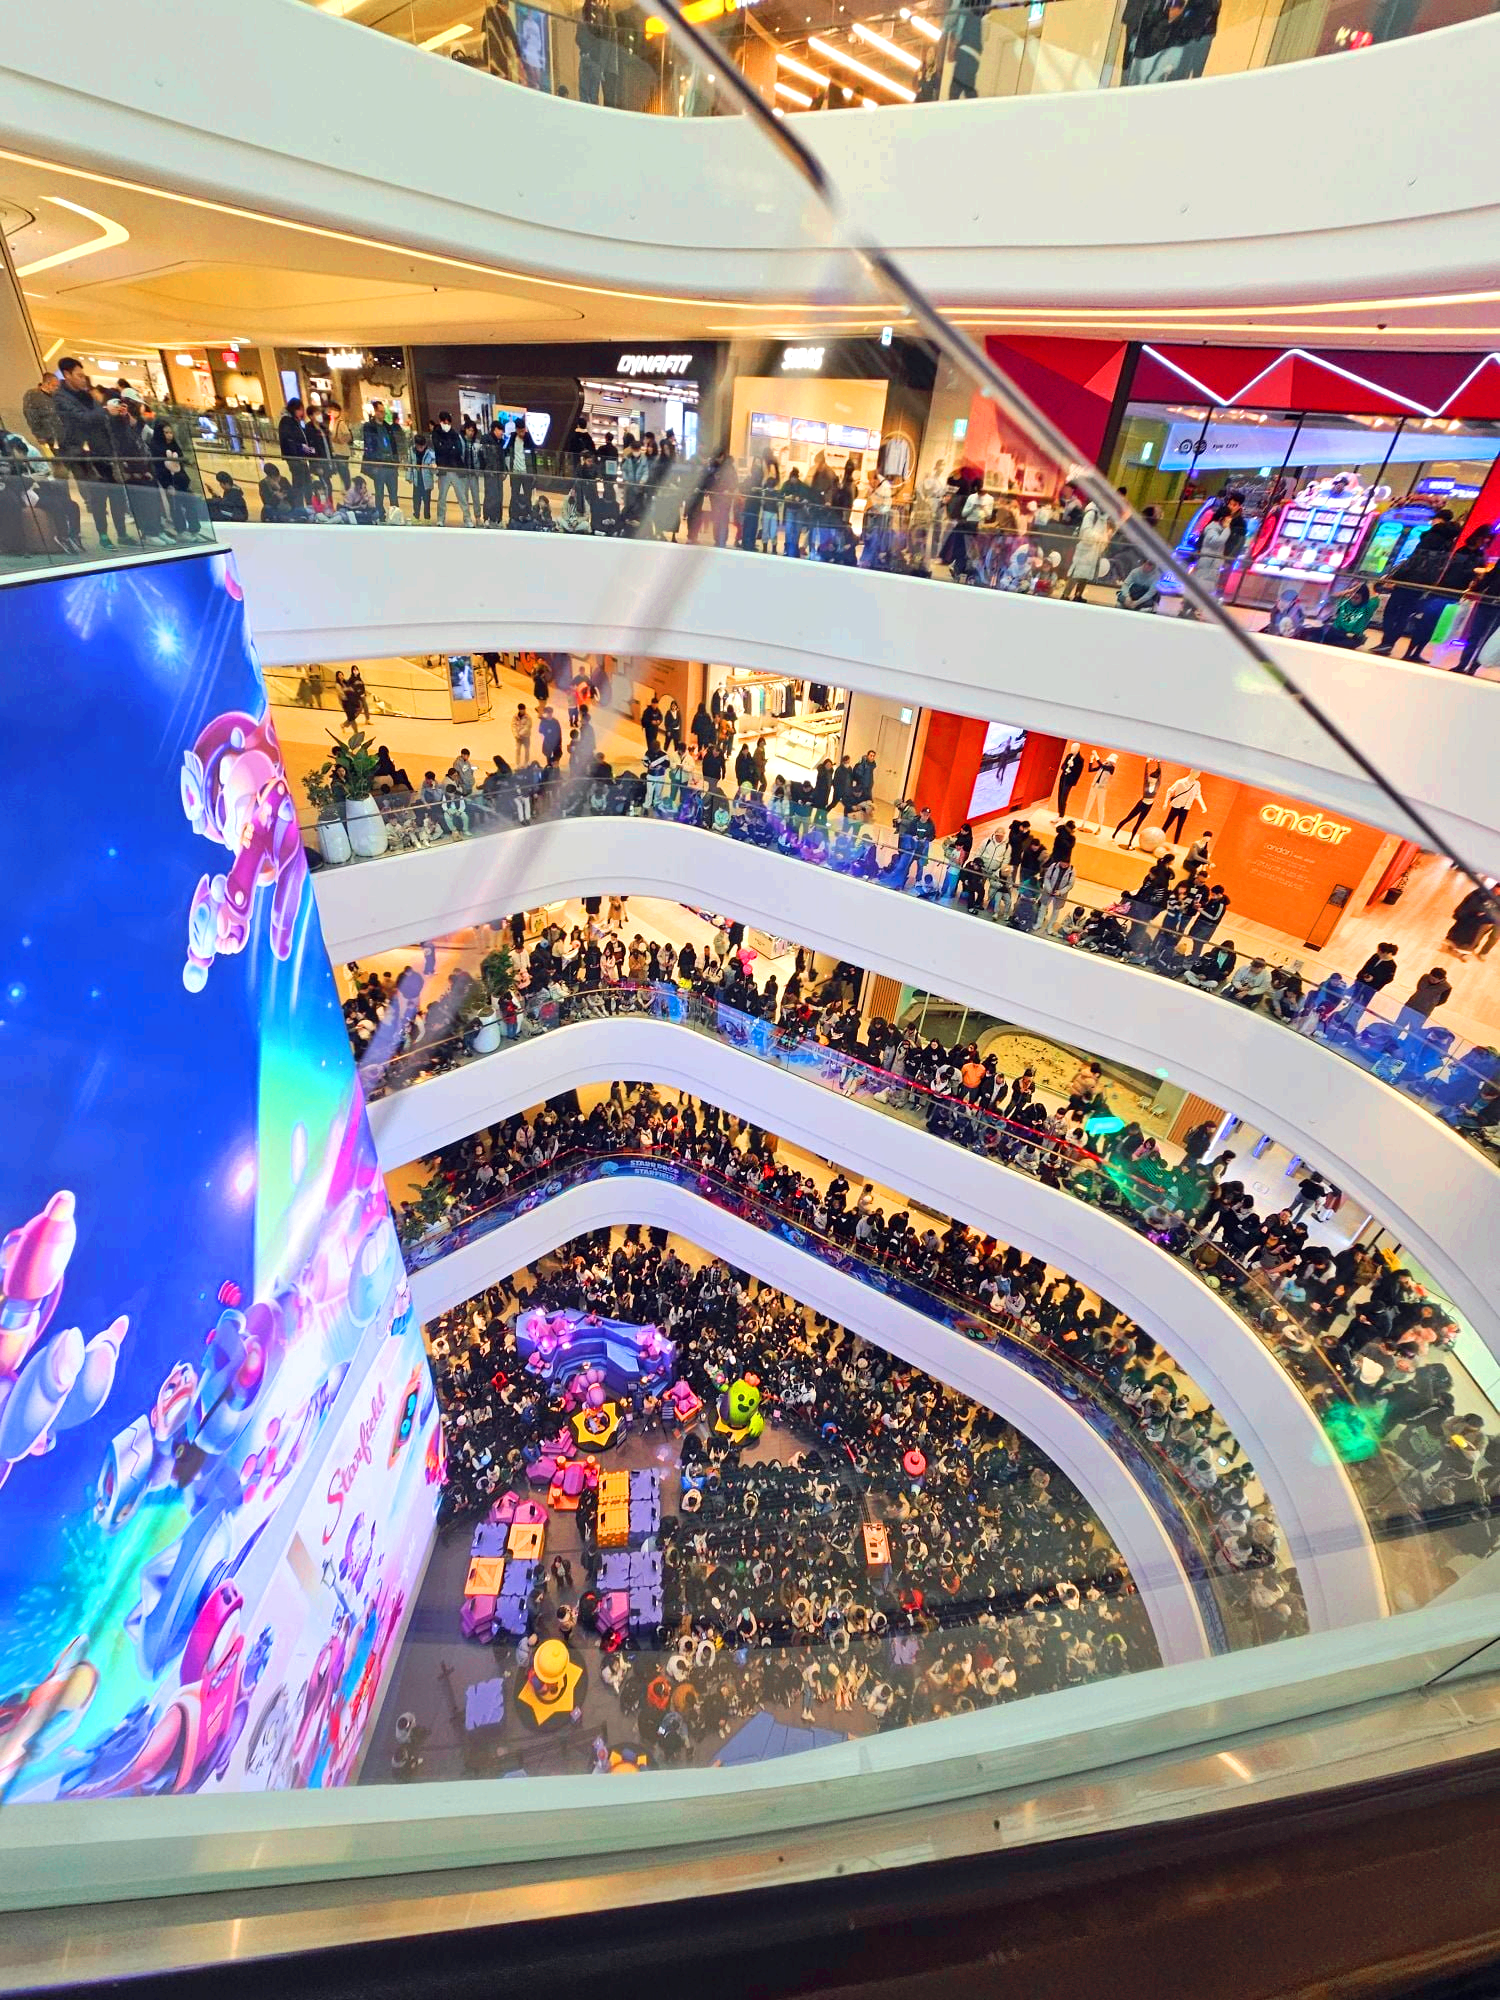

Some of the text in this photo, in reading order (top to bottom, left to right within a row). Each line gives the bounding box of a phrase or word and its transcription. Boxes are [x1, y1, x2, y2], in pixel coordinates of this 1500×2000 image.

[616, 354, 692, 376] DYNAFIT
[1260, 803, 1352, 845] andar
[323, 1382, 384, 1545] Starfield
